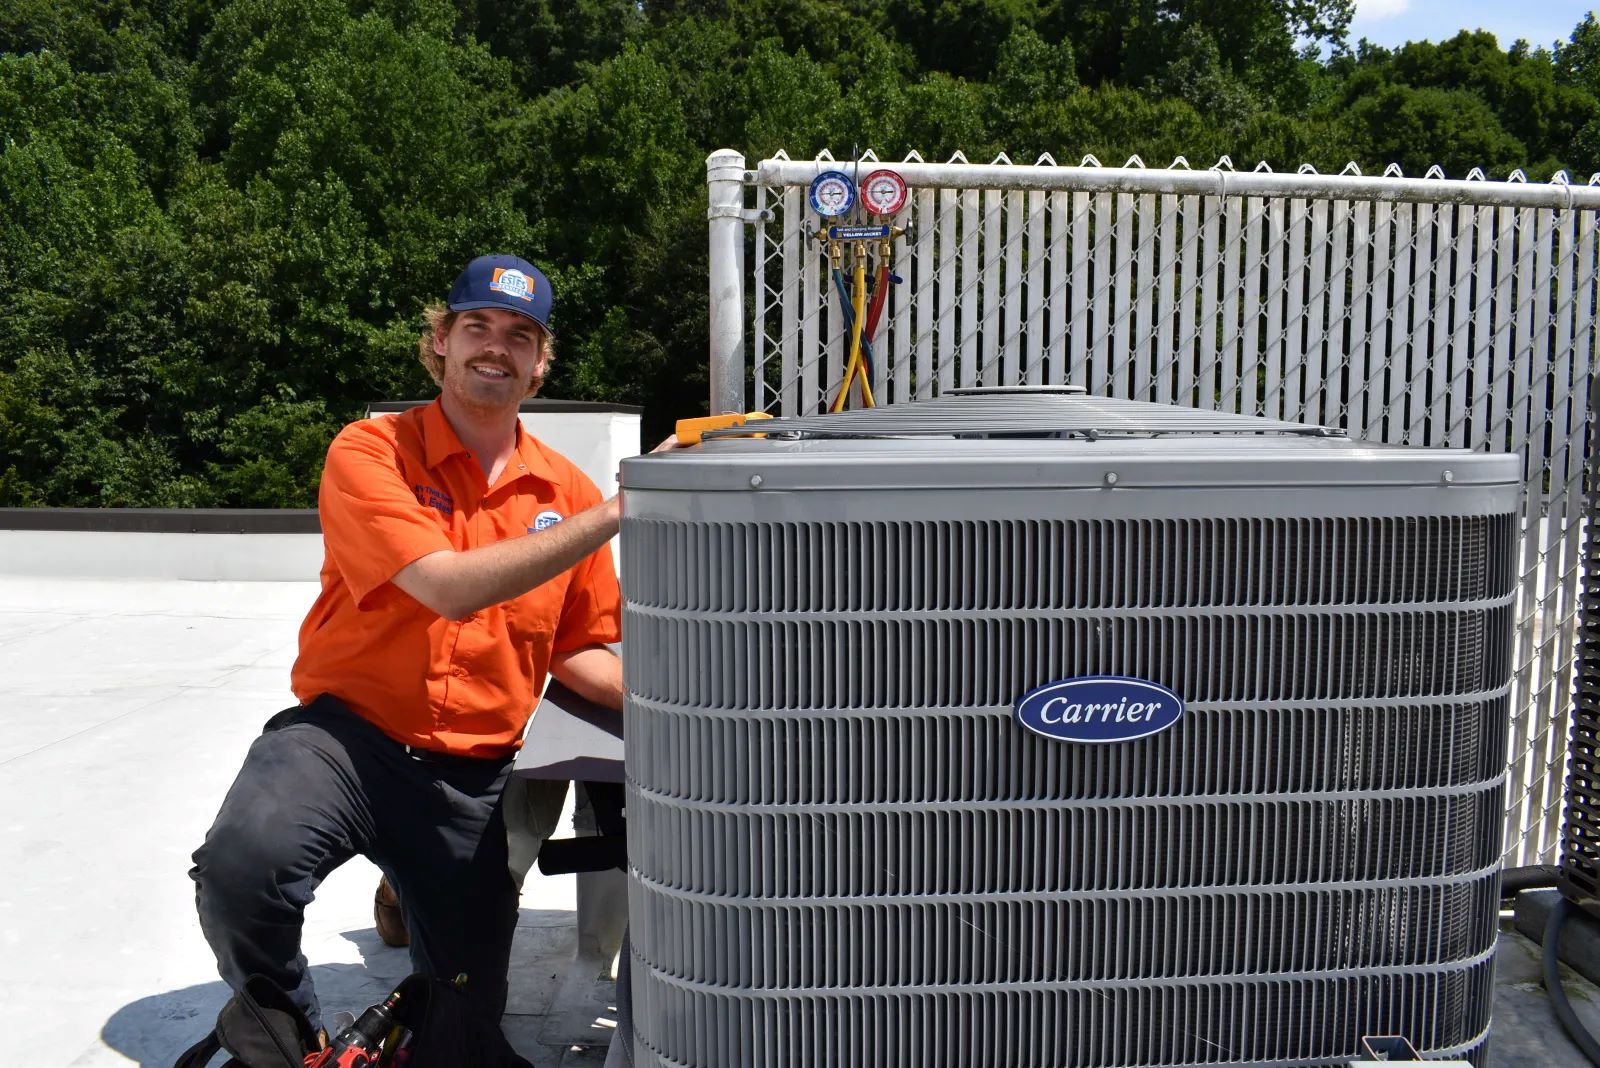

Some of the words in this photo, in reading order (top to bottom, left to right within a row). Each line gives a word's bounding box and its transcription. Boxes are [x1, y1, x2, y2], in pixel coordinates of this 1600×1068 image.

[501, 273, 526, 290] ESTES
[537, 515, 559, 529] EST
[1040, 696, 1162, 724] Carrier
